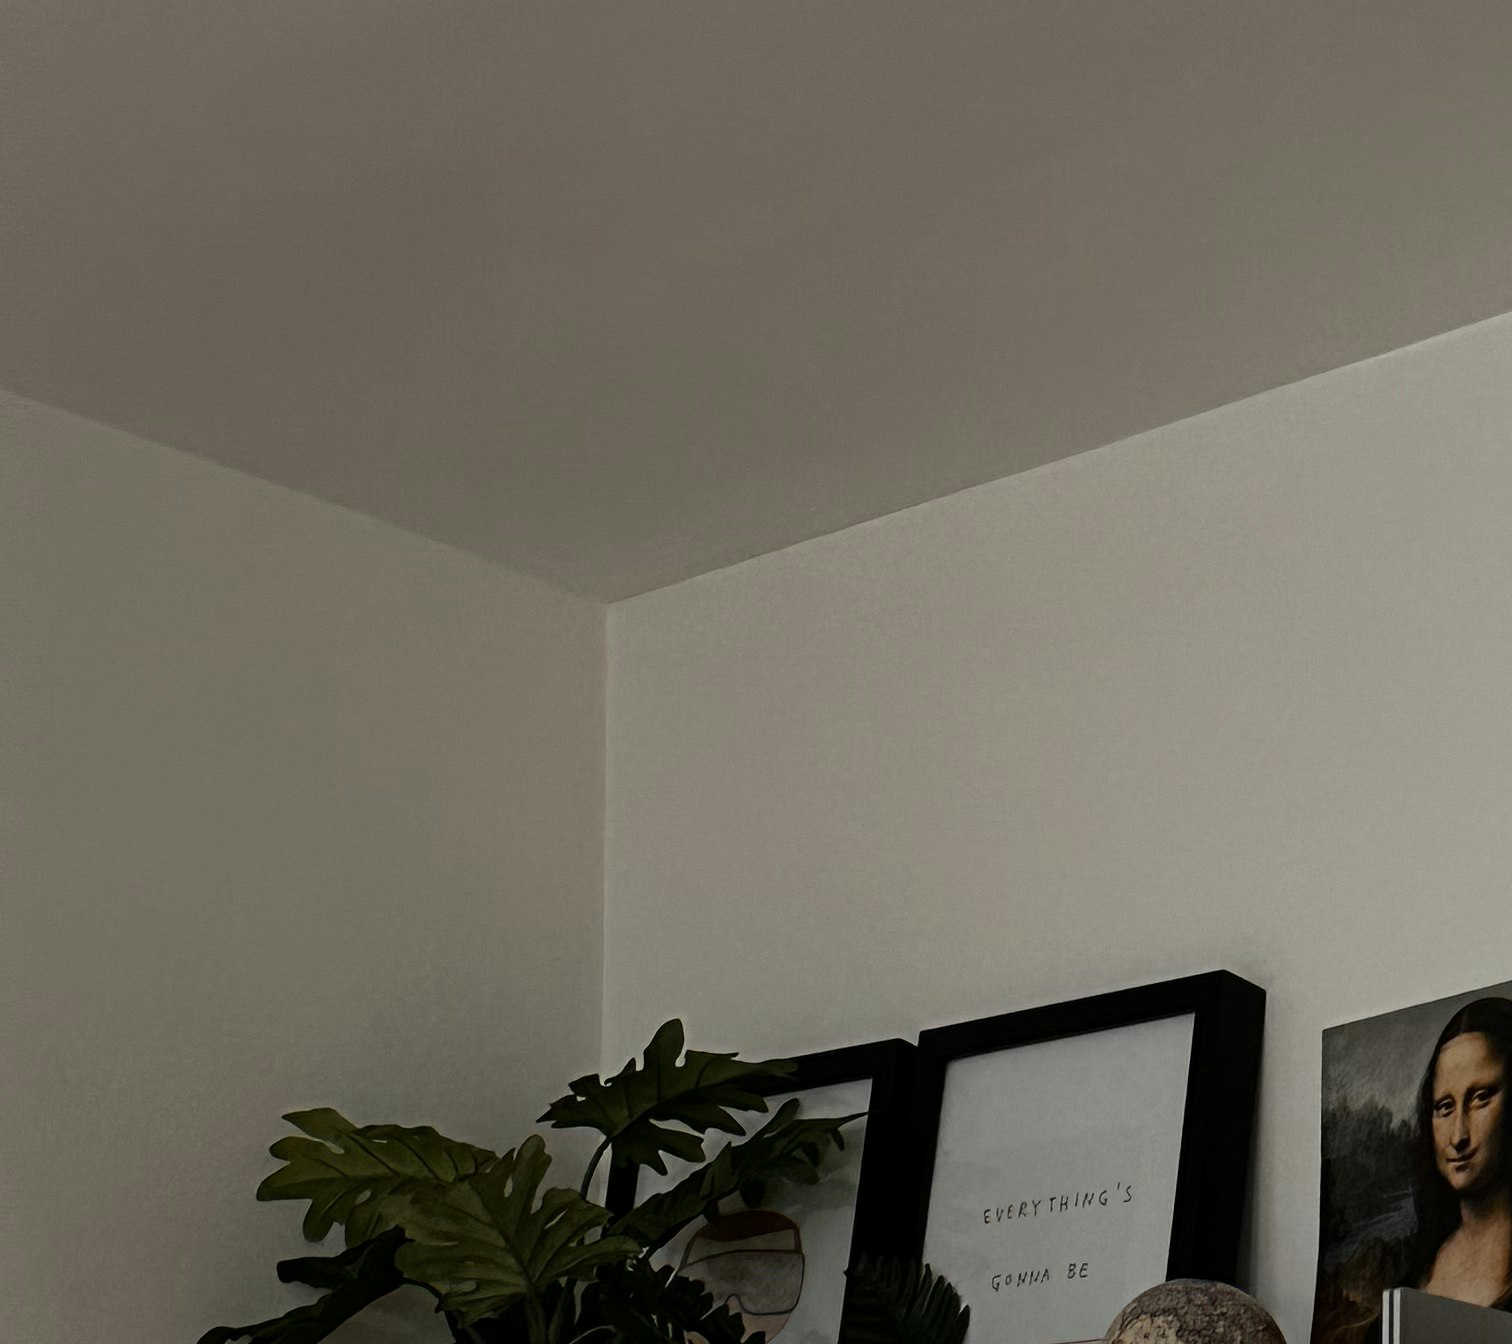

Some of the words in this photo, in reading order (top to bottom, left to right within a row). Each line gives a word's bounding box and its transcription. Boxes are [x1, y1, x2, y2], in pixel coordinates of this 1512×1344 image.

[983, 1181, 1133, 1224] EVERYTHING'S
[991, 1267, 1050, 1292] GONNA
[1067, 1262, 1089, 1279] BE
